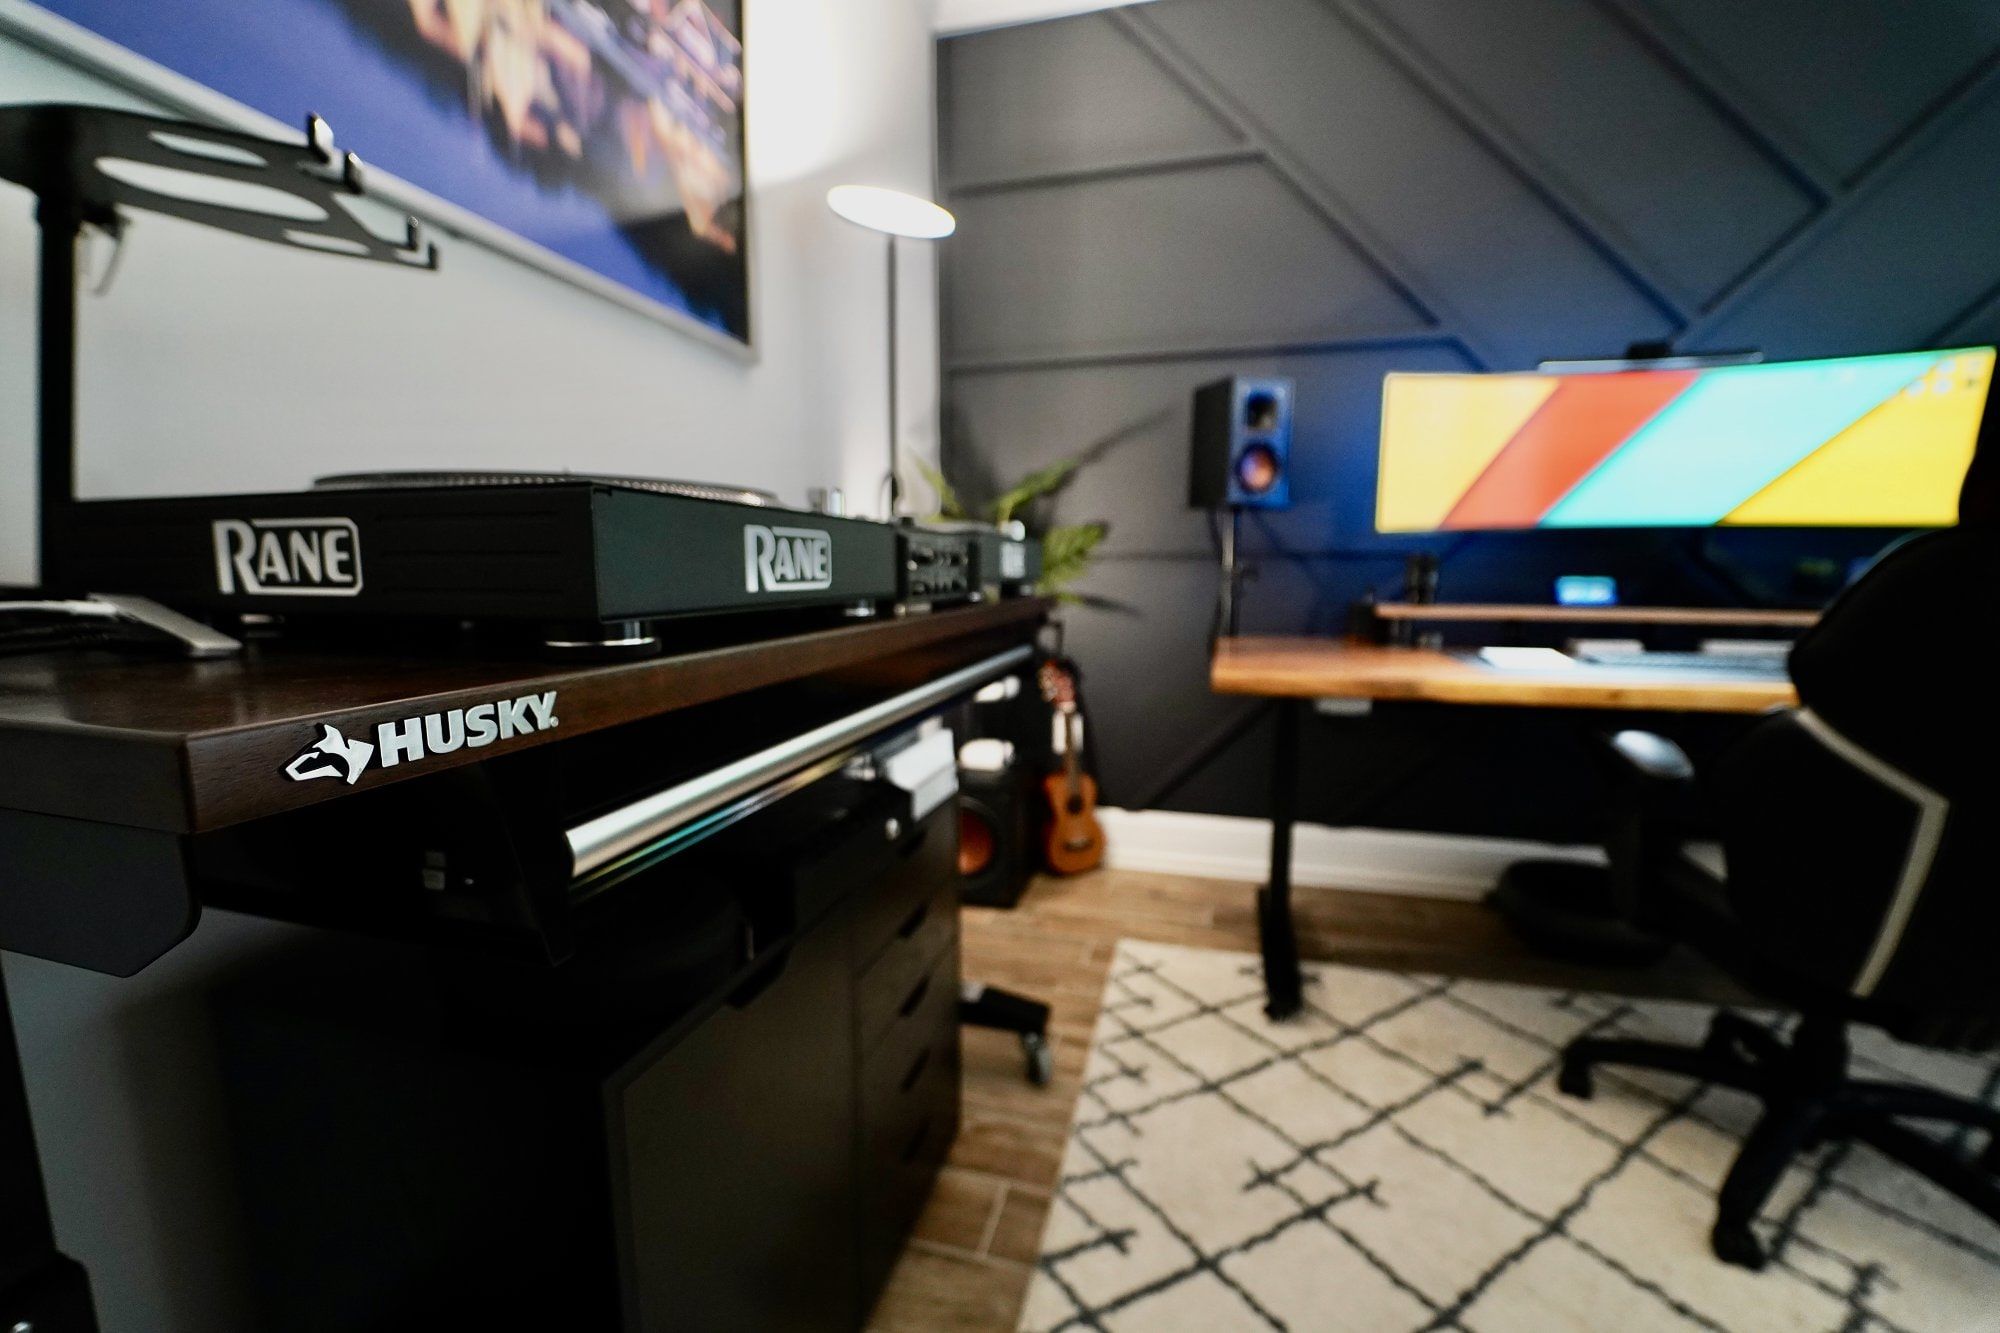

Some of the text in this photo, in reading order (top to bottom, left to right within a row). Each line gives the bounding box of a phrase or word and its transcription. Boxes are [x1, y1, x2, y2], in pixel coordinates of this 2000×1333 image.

[212, 519, 357, 594] RANE
[744, 524, 831, 593] RANE
[378, 691, 558, 767] HUSKY
